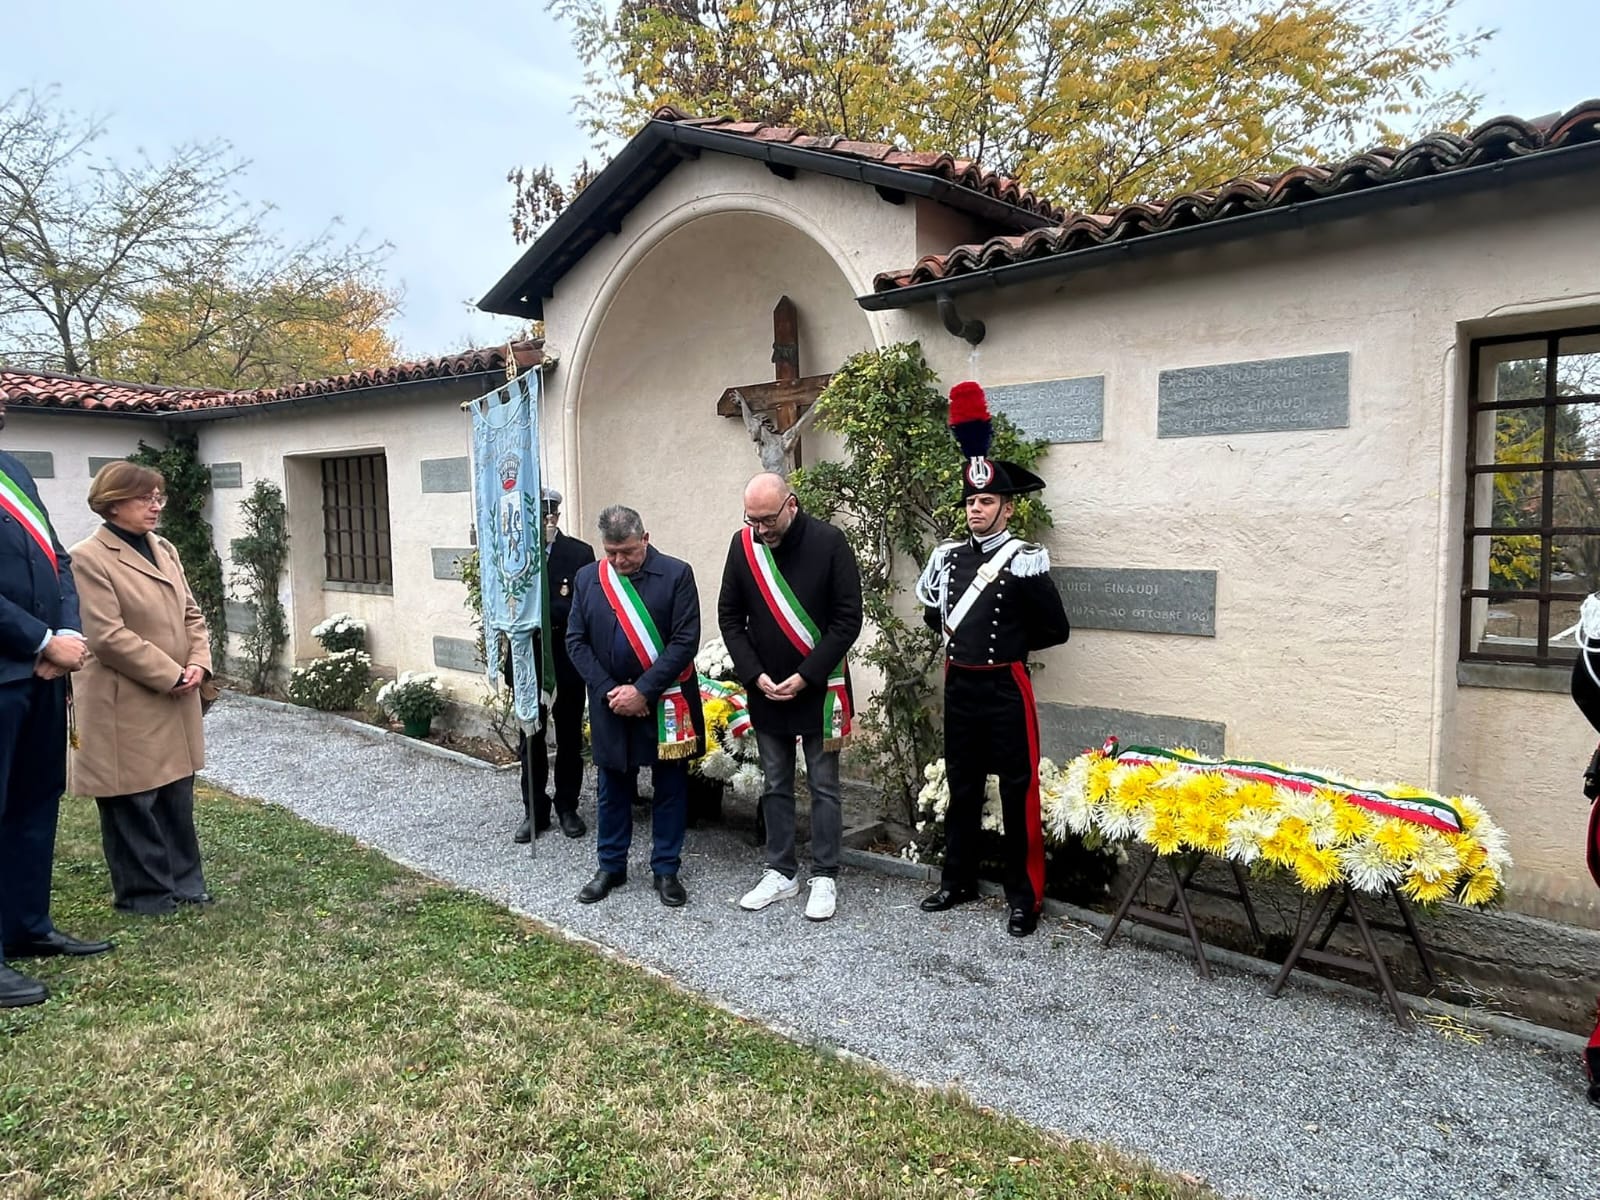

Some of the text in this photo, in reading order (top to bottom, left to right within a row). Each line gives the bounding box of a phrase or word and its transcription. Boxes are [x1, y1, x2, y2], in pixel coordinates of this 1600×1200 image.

[1060, 582, 1159, 595] LUIGI EINAUDI
[1131, 607, 1183, 621] OTTOBRE
